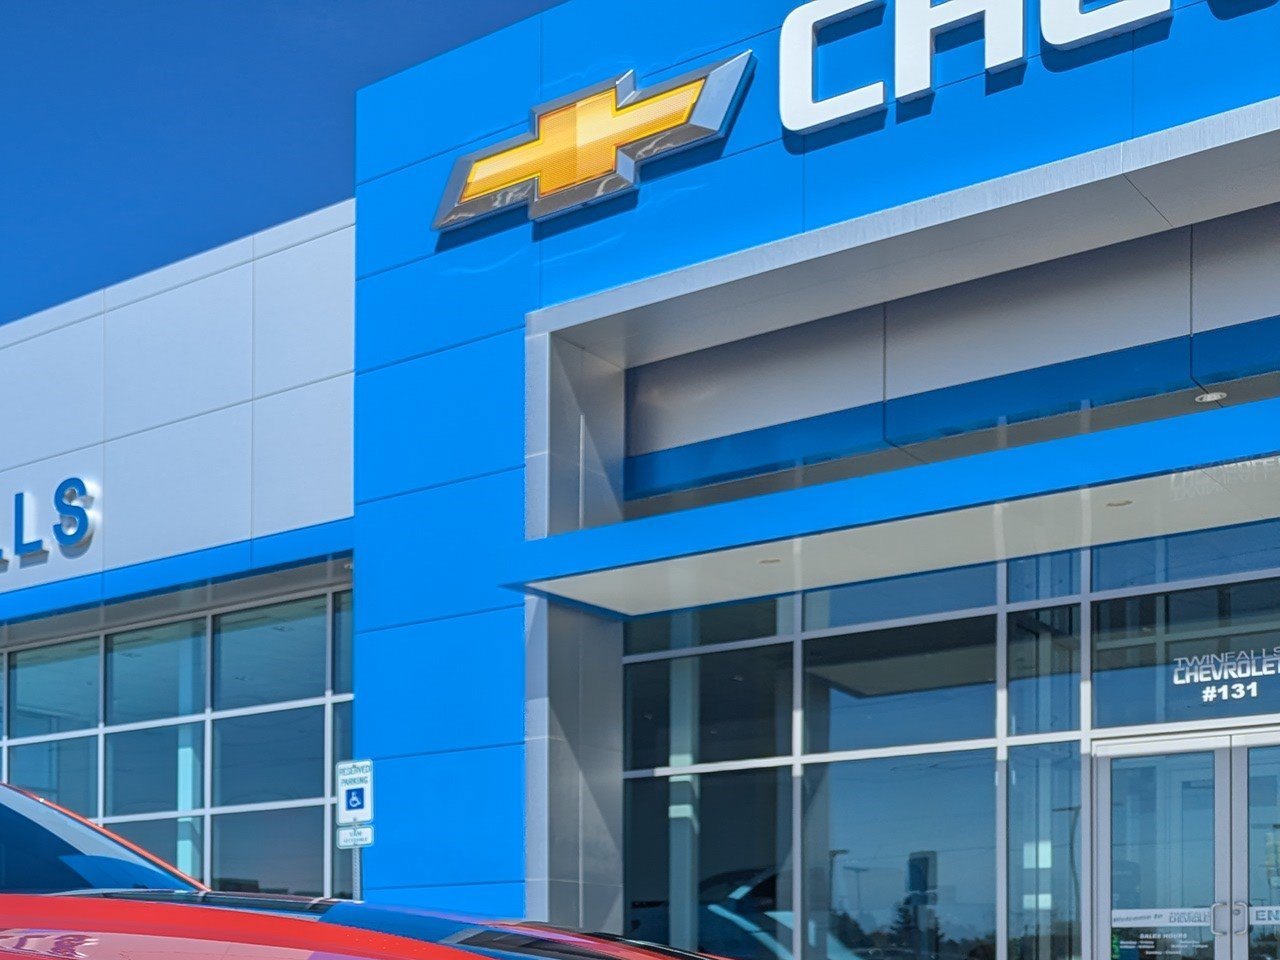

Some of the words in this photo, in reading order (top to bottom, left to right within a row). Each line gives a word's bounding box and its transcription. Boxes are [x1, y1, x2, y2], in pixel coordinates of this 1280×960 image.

[1202, 681, 1257, 702] #131
[340, 765, 371, 776] RESERVED
[341, 776, 368, 786] PARKING
